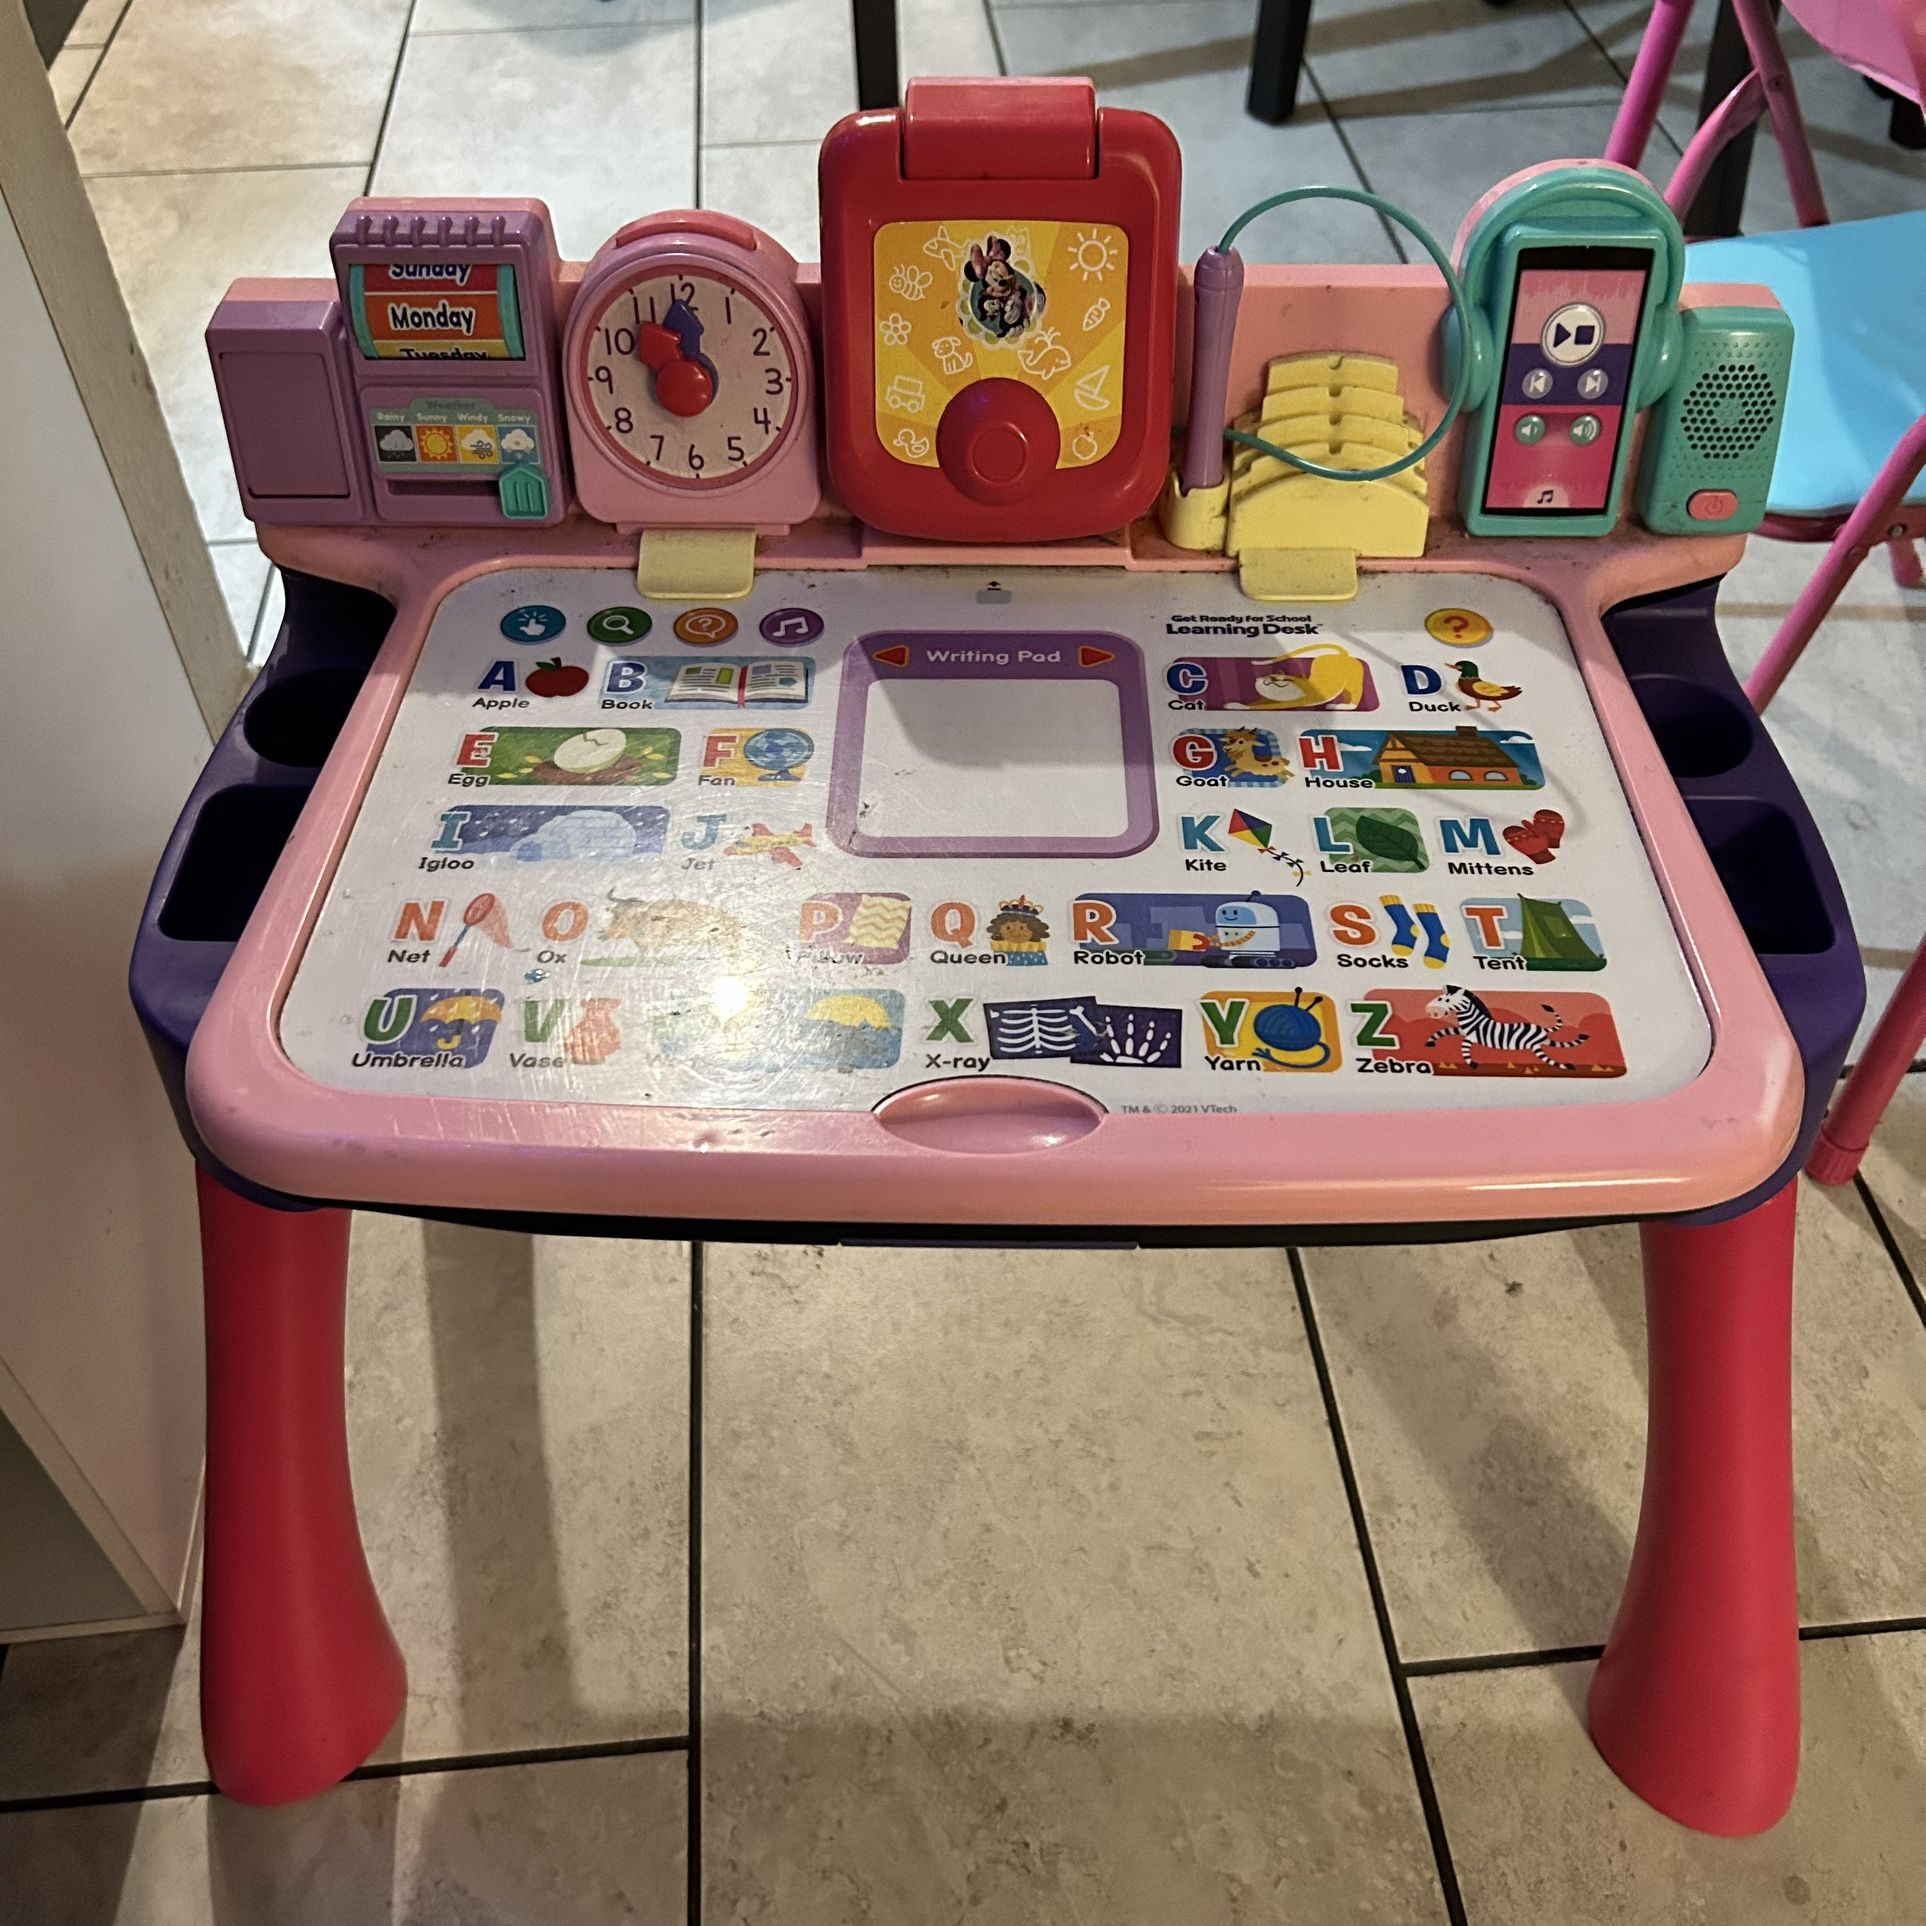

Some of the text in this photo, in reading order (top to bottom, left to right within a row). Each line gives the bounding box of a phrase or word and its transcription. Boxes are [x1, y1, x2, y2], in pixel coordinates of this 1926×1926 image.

[391, 264, 470, 284] Sunday
[391, 303, 473, 334] Monday
[633, 296, 656, 324] 11
[725, 296, 732, 324] 1
[604, 327, 635, 356] 10
[752, 328, 770, 356] 2
[595, 365, 613, 394] 9
[764, 368, 784, 395] 3
[377, 412, 530, 424] Rainy Sunny Windy Snowy
[426, 400, 476, 410] Weather
[614, 407, 633, 434] 8
[753, 408, 771, 435] 4
[650, 435, 665, 461] 7
[688, 444, 705, 470] 6
[727, 436, 745, 461] 5
[1166, 624, 1260, 638] Learning
[1200, 615, 1243, 624] Ready
[926, 650, 1061, 665] Writing Pad
[478, 661, 516, 691] A
[606, 661, 647, 693] B
[1167, 663, 1207, 694] C
[1402, 664, 1441, 695] D
[472, 697, 530, 710] Apple
[601, 698, 653, 711] Book
[1168, 698, 1205, 711] Cat
[1409, 700, 1461, 713] Duck
[456, 733, 496, 767] E
[703, 735, 737, 767] F
[1173, 736, 1216, 769] G
[1300, 736, 1342, 770] H
[448, 774, 490, 788] Egg
[699, 775, 735, 787] Fan
[1176, 776, 1228, 788] Goat
[1305, 776, 1374, 789] House
[431, 814, 469, 850] I
[681, 814, 728, 850] J
[1181, 816, 1225, 851] K
[1314, 817, 1351, 853] L
[1440, 818, 1500, 856] M
[419, 857, 474, 873] Igloo
[681, 859, 715, 871] Jet
[1185, 859, 1227, 872] Kite
[1321, 860, 1371, 874] Leaf
[1448, 862, 1534, 877] Mittens
[394, 901, 445, 941] N
[542, 901, 589, 942] O
[800, 901, 840, 941] P
[931, 902, 976, 948] Q
[1073, 902, 1116, 943] R
[1329, 903, 1376, 945] S
[1465, 907, 1505, 947] T
[388, 949, 430, 963] Net
[537, 950, 566, 963] Ox
[930, 951, 1006, 966] Queen
[1073, 950, 1144, 966] Robot
[1337, 953, 1409, 969] Socks
[1473, 955, 1526, 971] Tent
[364, 997, 413, 1042] U
[523, 1000, 565, 1043] V
[926, 999, 974, 1043] X
[1201, 1001, 1246, 1045] Y
[1351, 1003, 1396, 1048] Z
[352, 1053, 465, 1068] Umbrella
[511, 1053, 567, 1068] Vase
[925, 1053, 991, 1071] X-ray
[1204, 1055, 1262, 1072] Yarn
[1357, 1057, 1431, 1074] Zebra
[1121, 1105, 1139, 1114] TM
[1142, 1105, 1151, 1113] &
[1171, 1105, 1198, 1114] 2021
[1201, 1104, 1237, 1113] VTech
